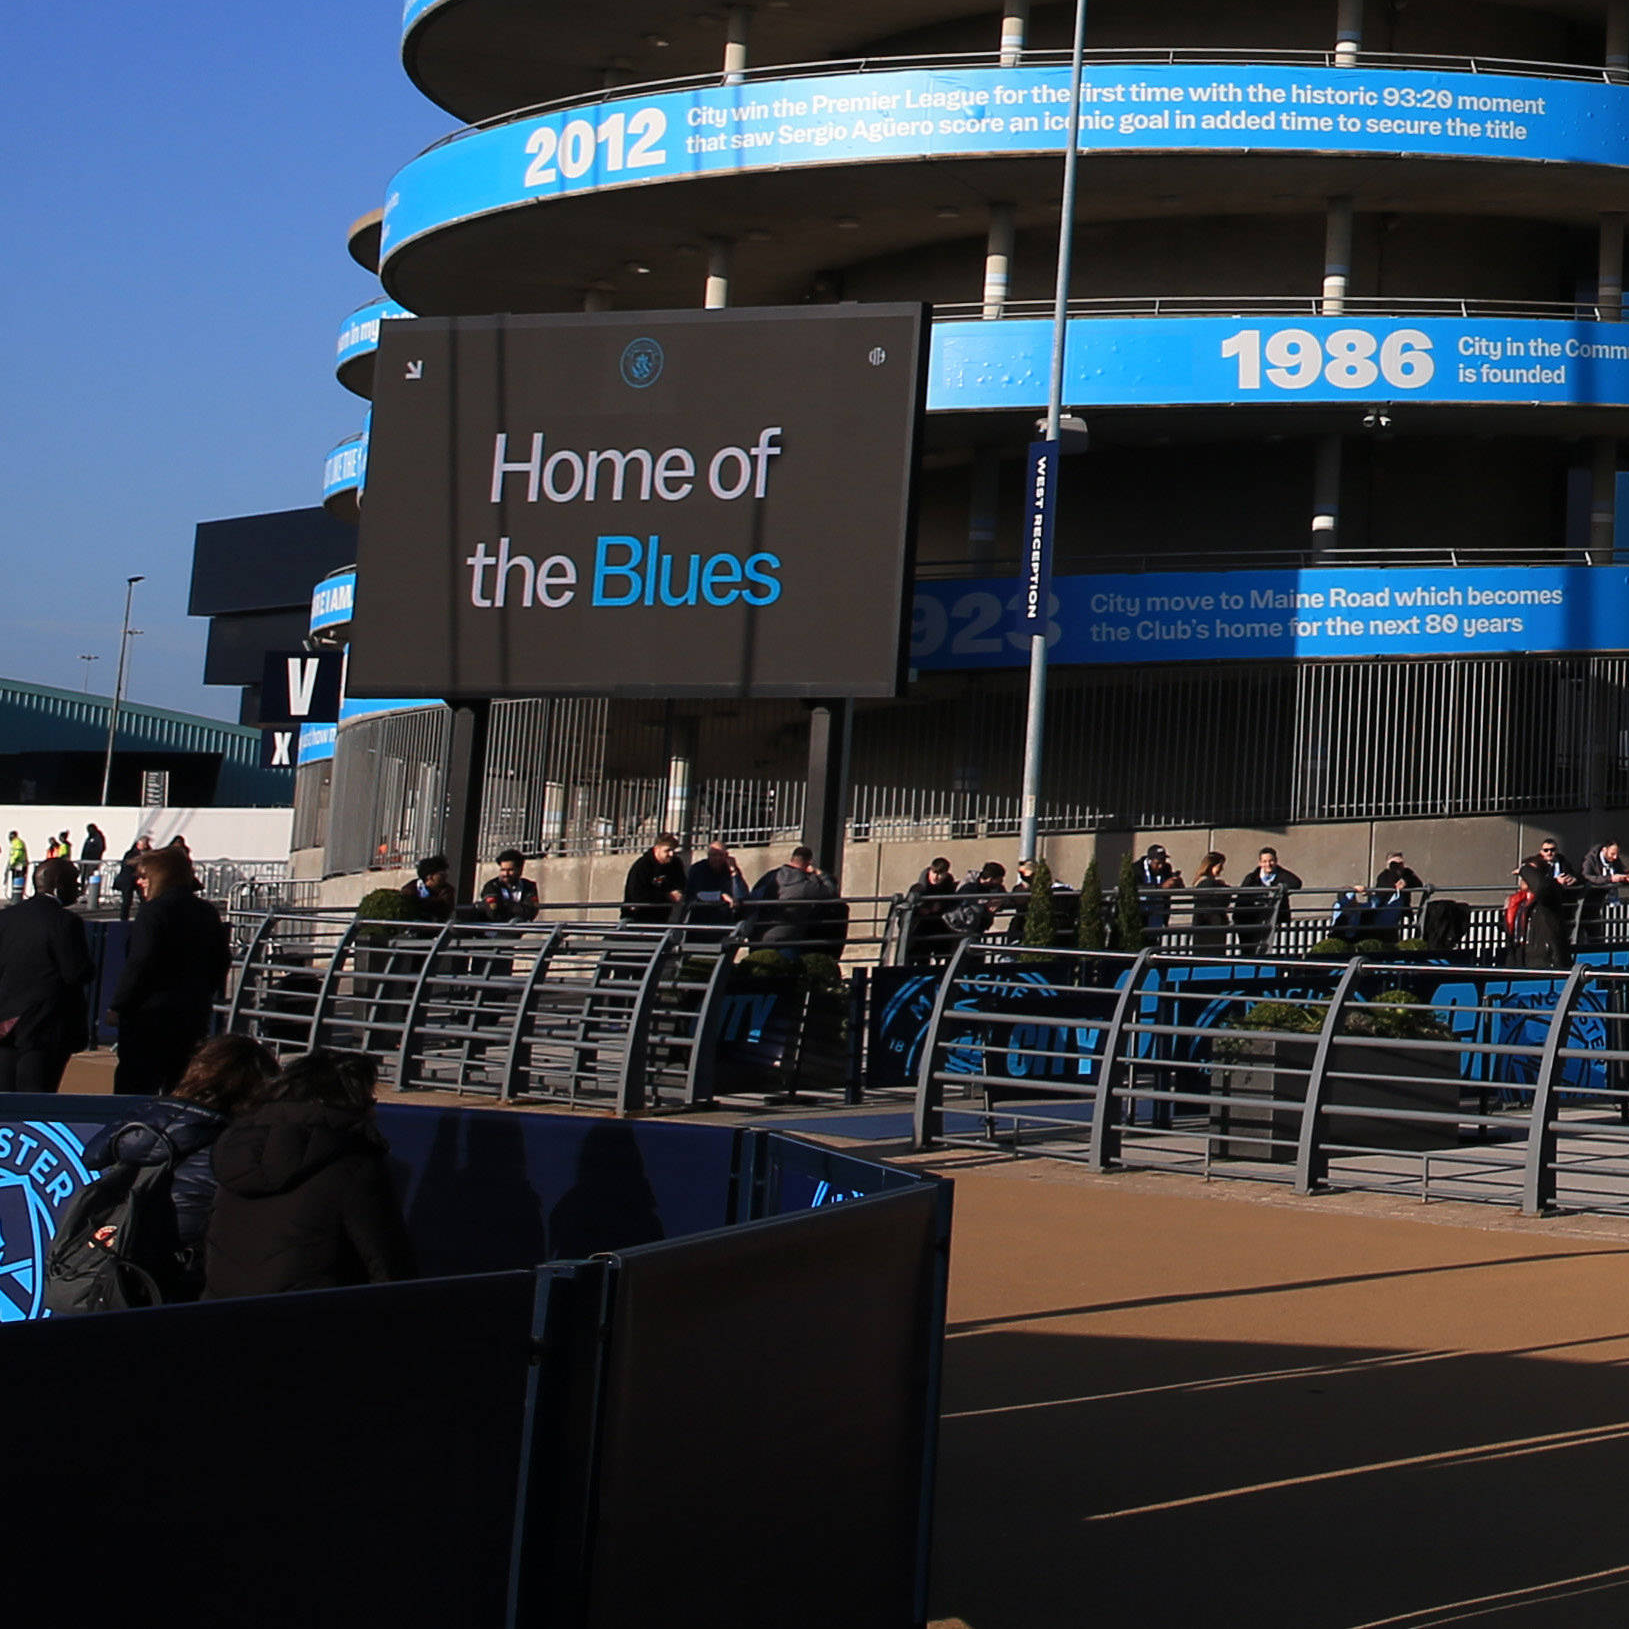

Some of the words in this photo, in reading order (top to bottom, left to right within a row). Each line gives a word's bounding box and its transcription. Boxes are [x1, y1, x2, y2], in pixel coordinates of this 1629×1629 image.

[524, 107, 666, 188] 2012
[686, 106, 727, 127] City
[773, 97, 808, 118] the
[812, 91, 901, 114] Premier
[993, 85, 1027, 105] for
[1030, 84, 1070, 105] the
[1079, 81, 1125, 103] first
[1129, 81, 1184, 103] time
[1246, 83, 1286, 104] the
[1292, 84, 1378, 107] historic
[1382, 87, 1453, 110] 93:20
[686, 132, 727, 154] that
[730, 132, 775, 152] saw
[851, 118, 934, 142] Agüero
[938, 116, 1004, 135] score
[1009, 113, 1038, 133] an
[1119, 110, 1169, 134] goal
[1201, 110, 1275, 131] added
[1279, 111, 1333, 132] time
[1366, 118, 1442, 137] secure
[1446, 117, 1482, 138] the
[1220, 328, 1435, 390] 1986
[1458, 336, 1502, 359] City
[1528, 337, 1562, 357] the
[1481, 364, 1566, 385] founded
[490, 431, 694, 504] Home
[707, 426, 783, 501] of
[1035, 456, 1047, 509] WEST
[466, 538, 577, 610] the
[592, 535, 782, 608] Blues
[1027, 514, 1043, 618] RECEPTION
[1090, 593, 1140, 616] City
[1146, 594, 1215, 613] move
[1220, 590, 1244, 610] to
[1251, 589, 1324, 610] Maine
[1394, 586, 1462, 607] which
[1468, 586, 1563, 607] becomes
[1090, 622, 1130, 642] the
[1216, 620, 1282, 639] home
[1325, 616, 1364, 636] the
[1369, 617, 1420, 636] next
[1425, 614, 1458, 634] 80
[287, 658, 320, 716] V
[271, 732, 292, 765] X
